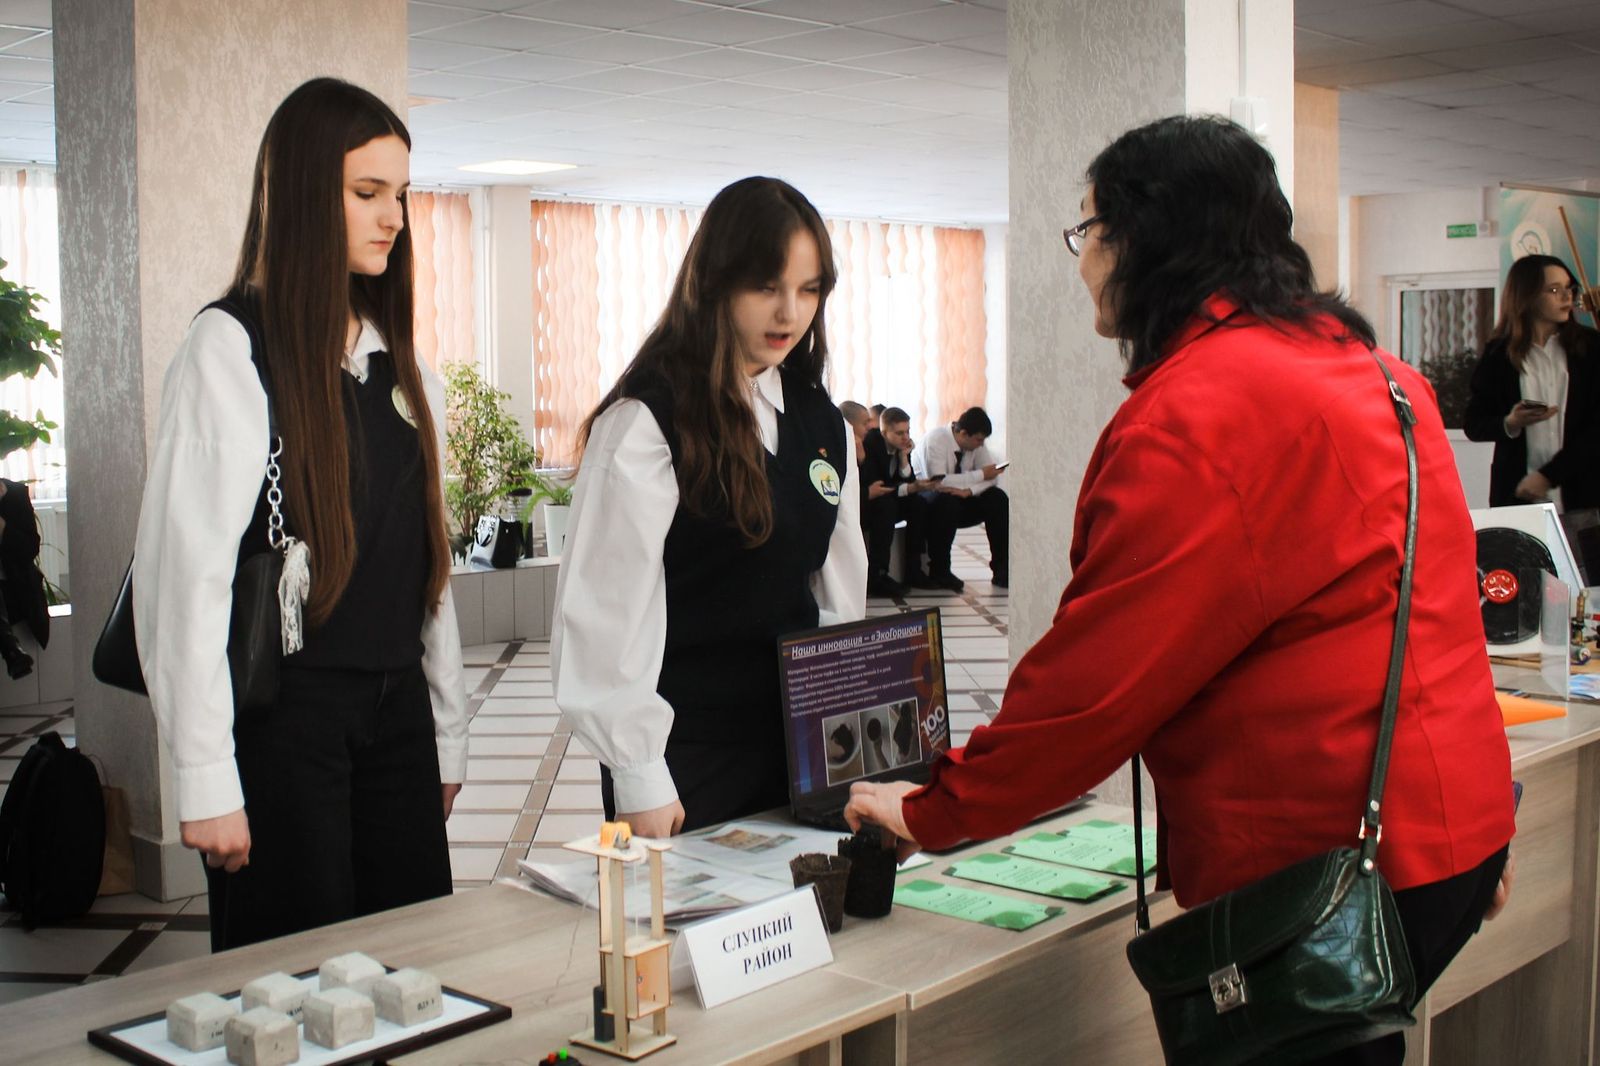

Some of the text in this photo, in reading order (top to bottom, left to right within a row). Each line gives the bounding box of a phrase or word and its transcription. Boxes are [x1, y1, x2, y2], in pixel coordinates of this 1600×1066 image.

[792, 644, 816, 659] Наша
[818, 636, 862, 654] инновация
[920, 705, 945, 737] 100
[722, 912, 793, 954] СЛУЦКИЙ
[743, 942, 792, 975] РАЙОН
